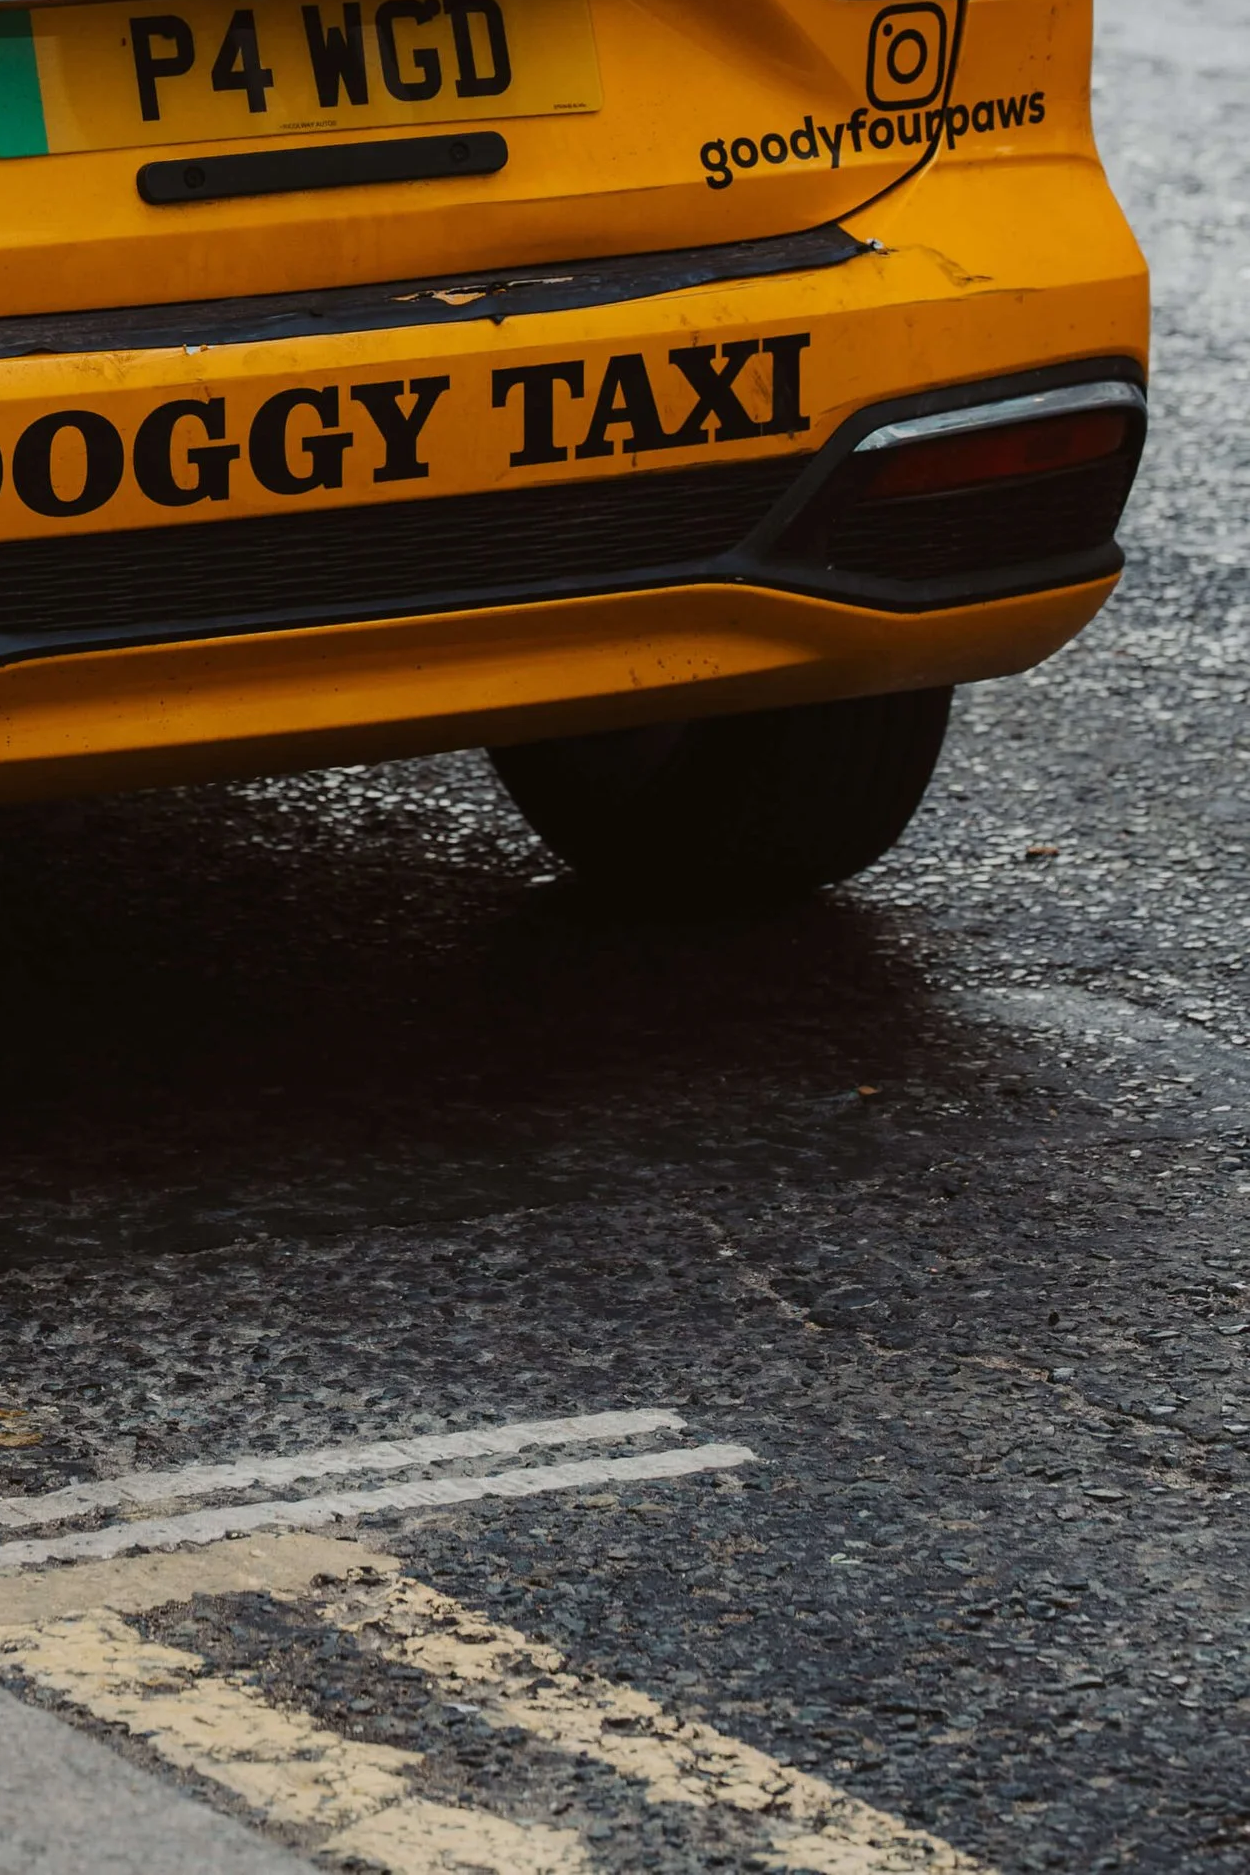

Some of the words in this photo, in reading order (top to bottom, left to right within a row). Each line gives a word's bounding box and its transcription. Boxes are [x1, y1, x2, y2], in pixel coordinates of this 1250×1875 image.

[128, 9, 275, 122] P4
[699, 91, 1046, 190] goodyfourpaws
[491, 332, 811, 468] TAXI
